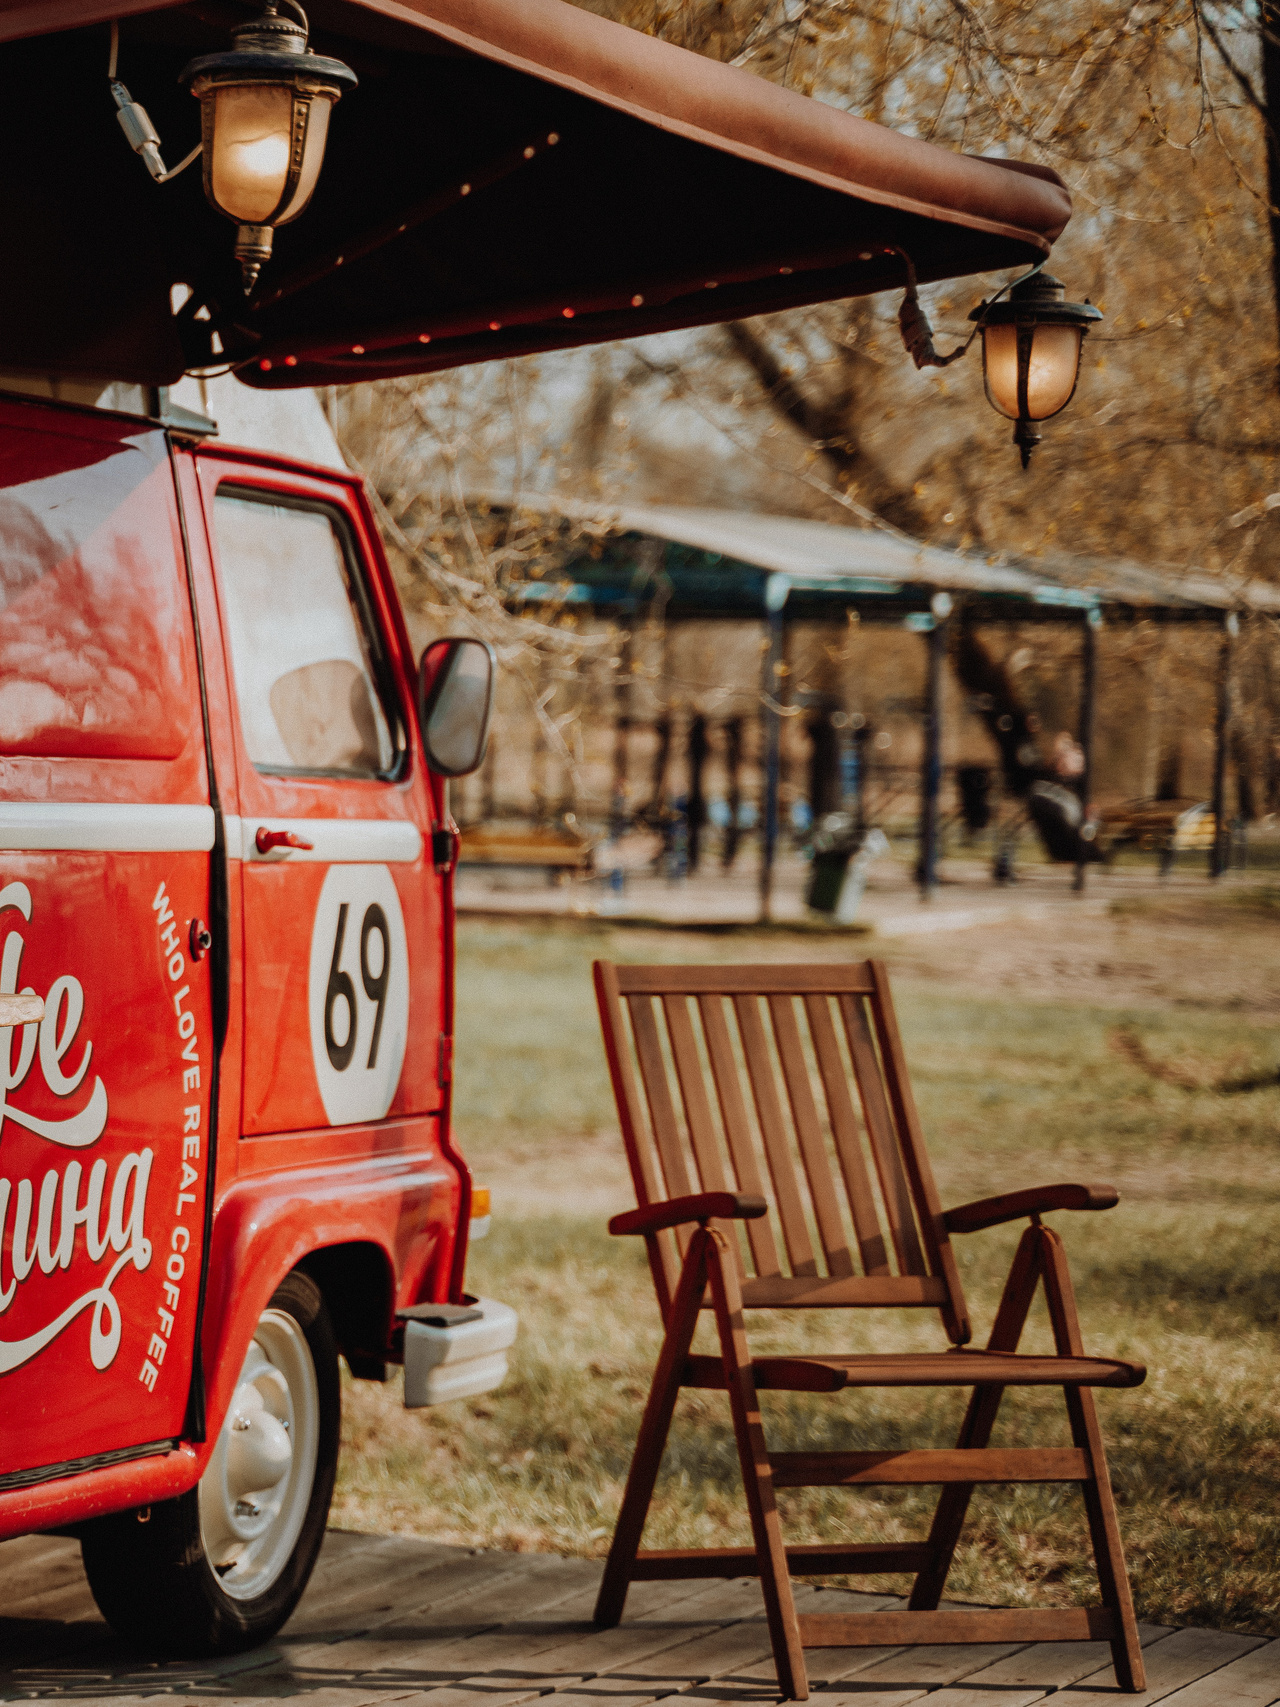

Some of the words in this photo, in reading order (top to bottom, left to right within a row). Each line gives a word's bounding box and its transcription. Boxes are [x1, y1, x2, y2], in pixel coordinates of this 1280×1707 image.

[152, 881, 185, 981] WHO
[173, 985, 201, 1094] LOVE
[324, 903, 391, 1072] 69
[176, 1104, 201, 1216] REAL
[138, 1226, 190, 1393] COFFEE
